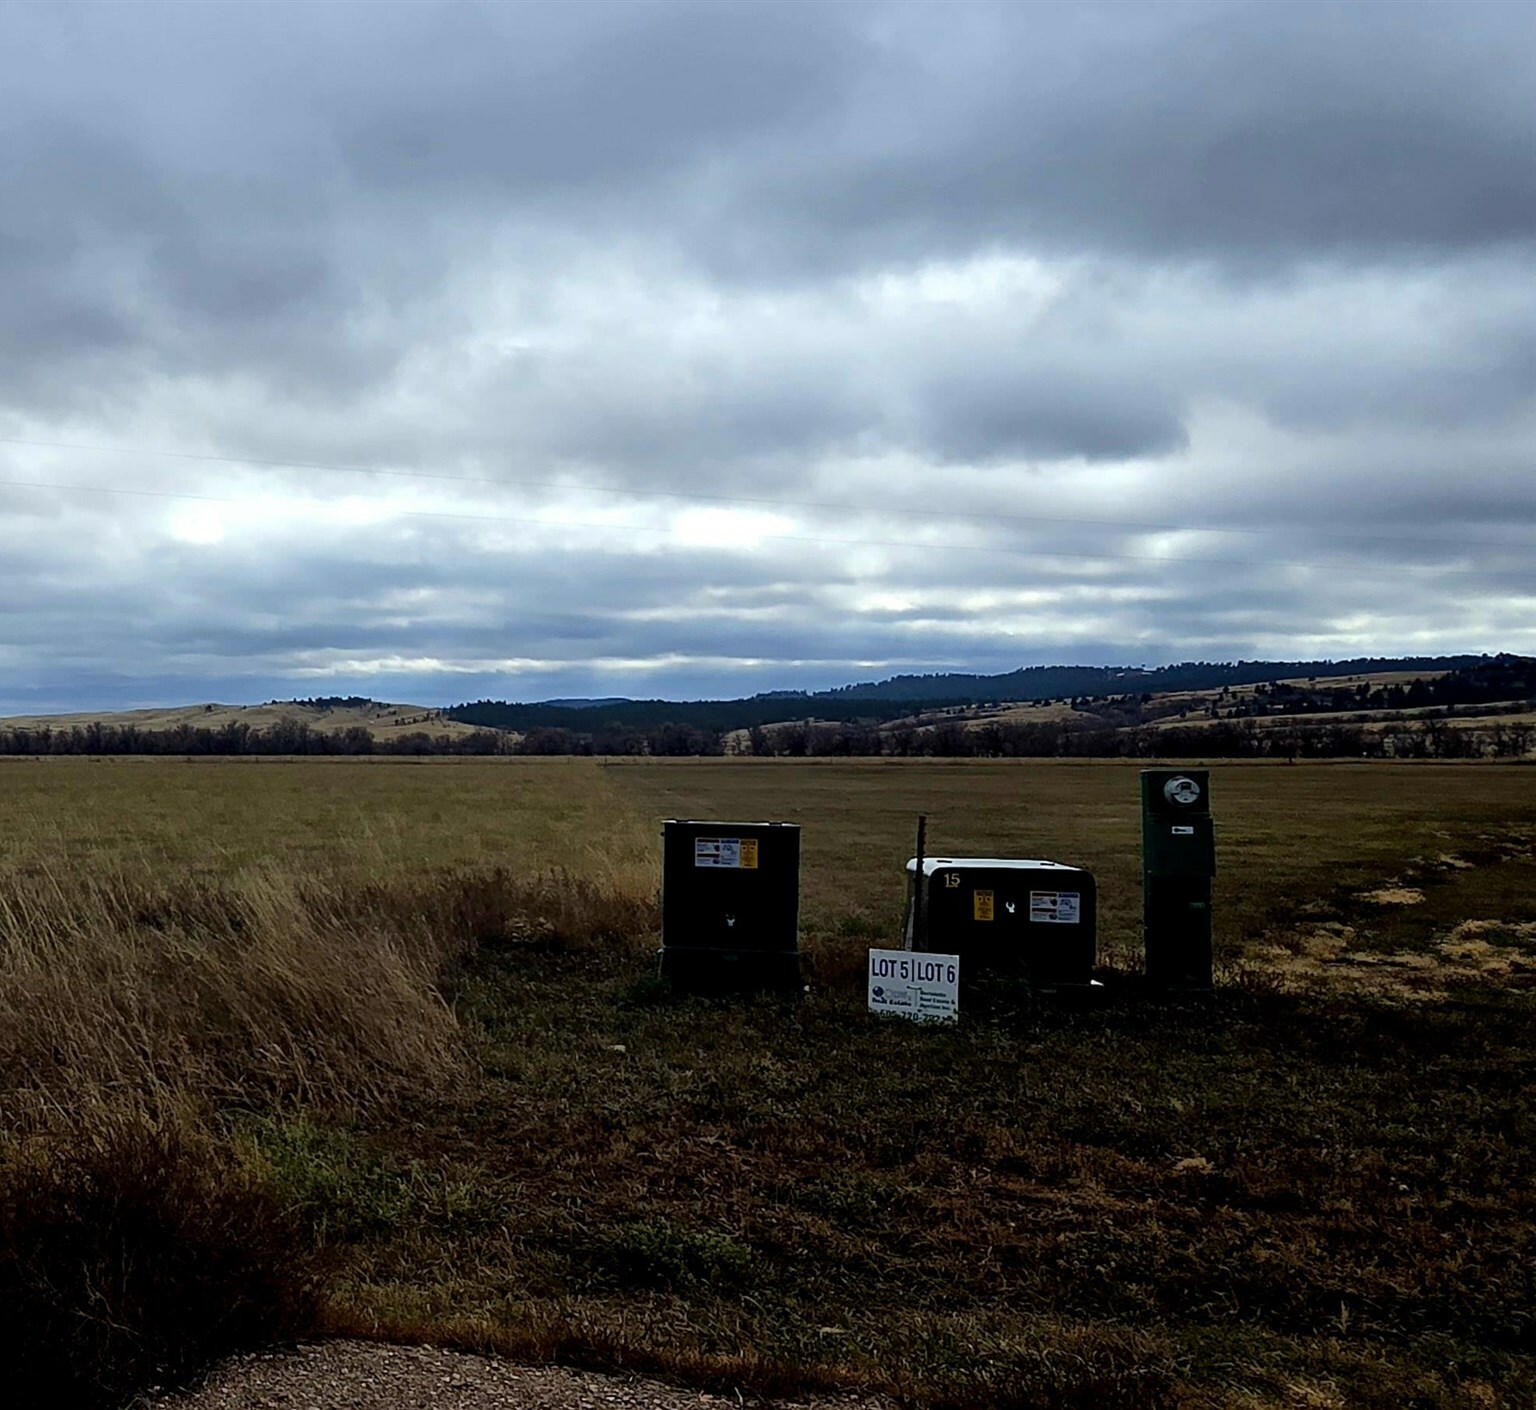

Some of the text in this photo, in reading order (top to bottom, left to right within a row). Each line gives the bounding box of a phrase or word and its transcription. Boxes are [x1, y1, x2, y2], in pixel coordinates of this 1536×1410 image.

[944, 873, 961, 887] 15
[872, 958, 955, 983] LOT 5 LOT 6
